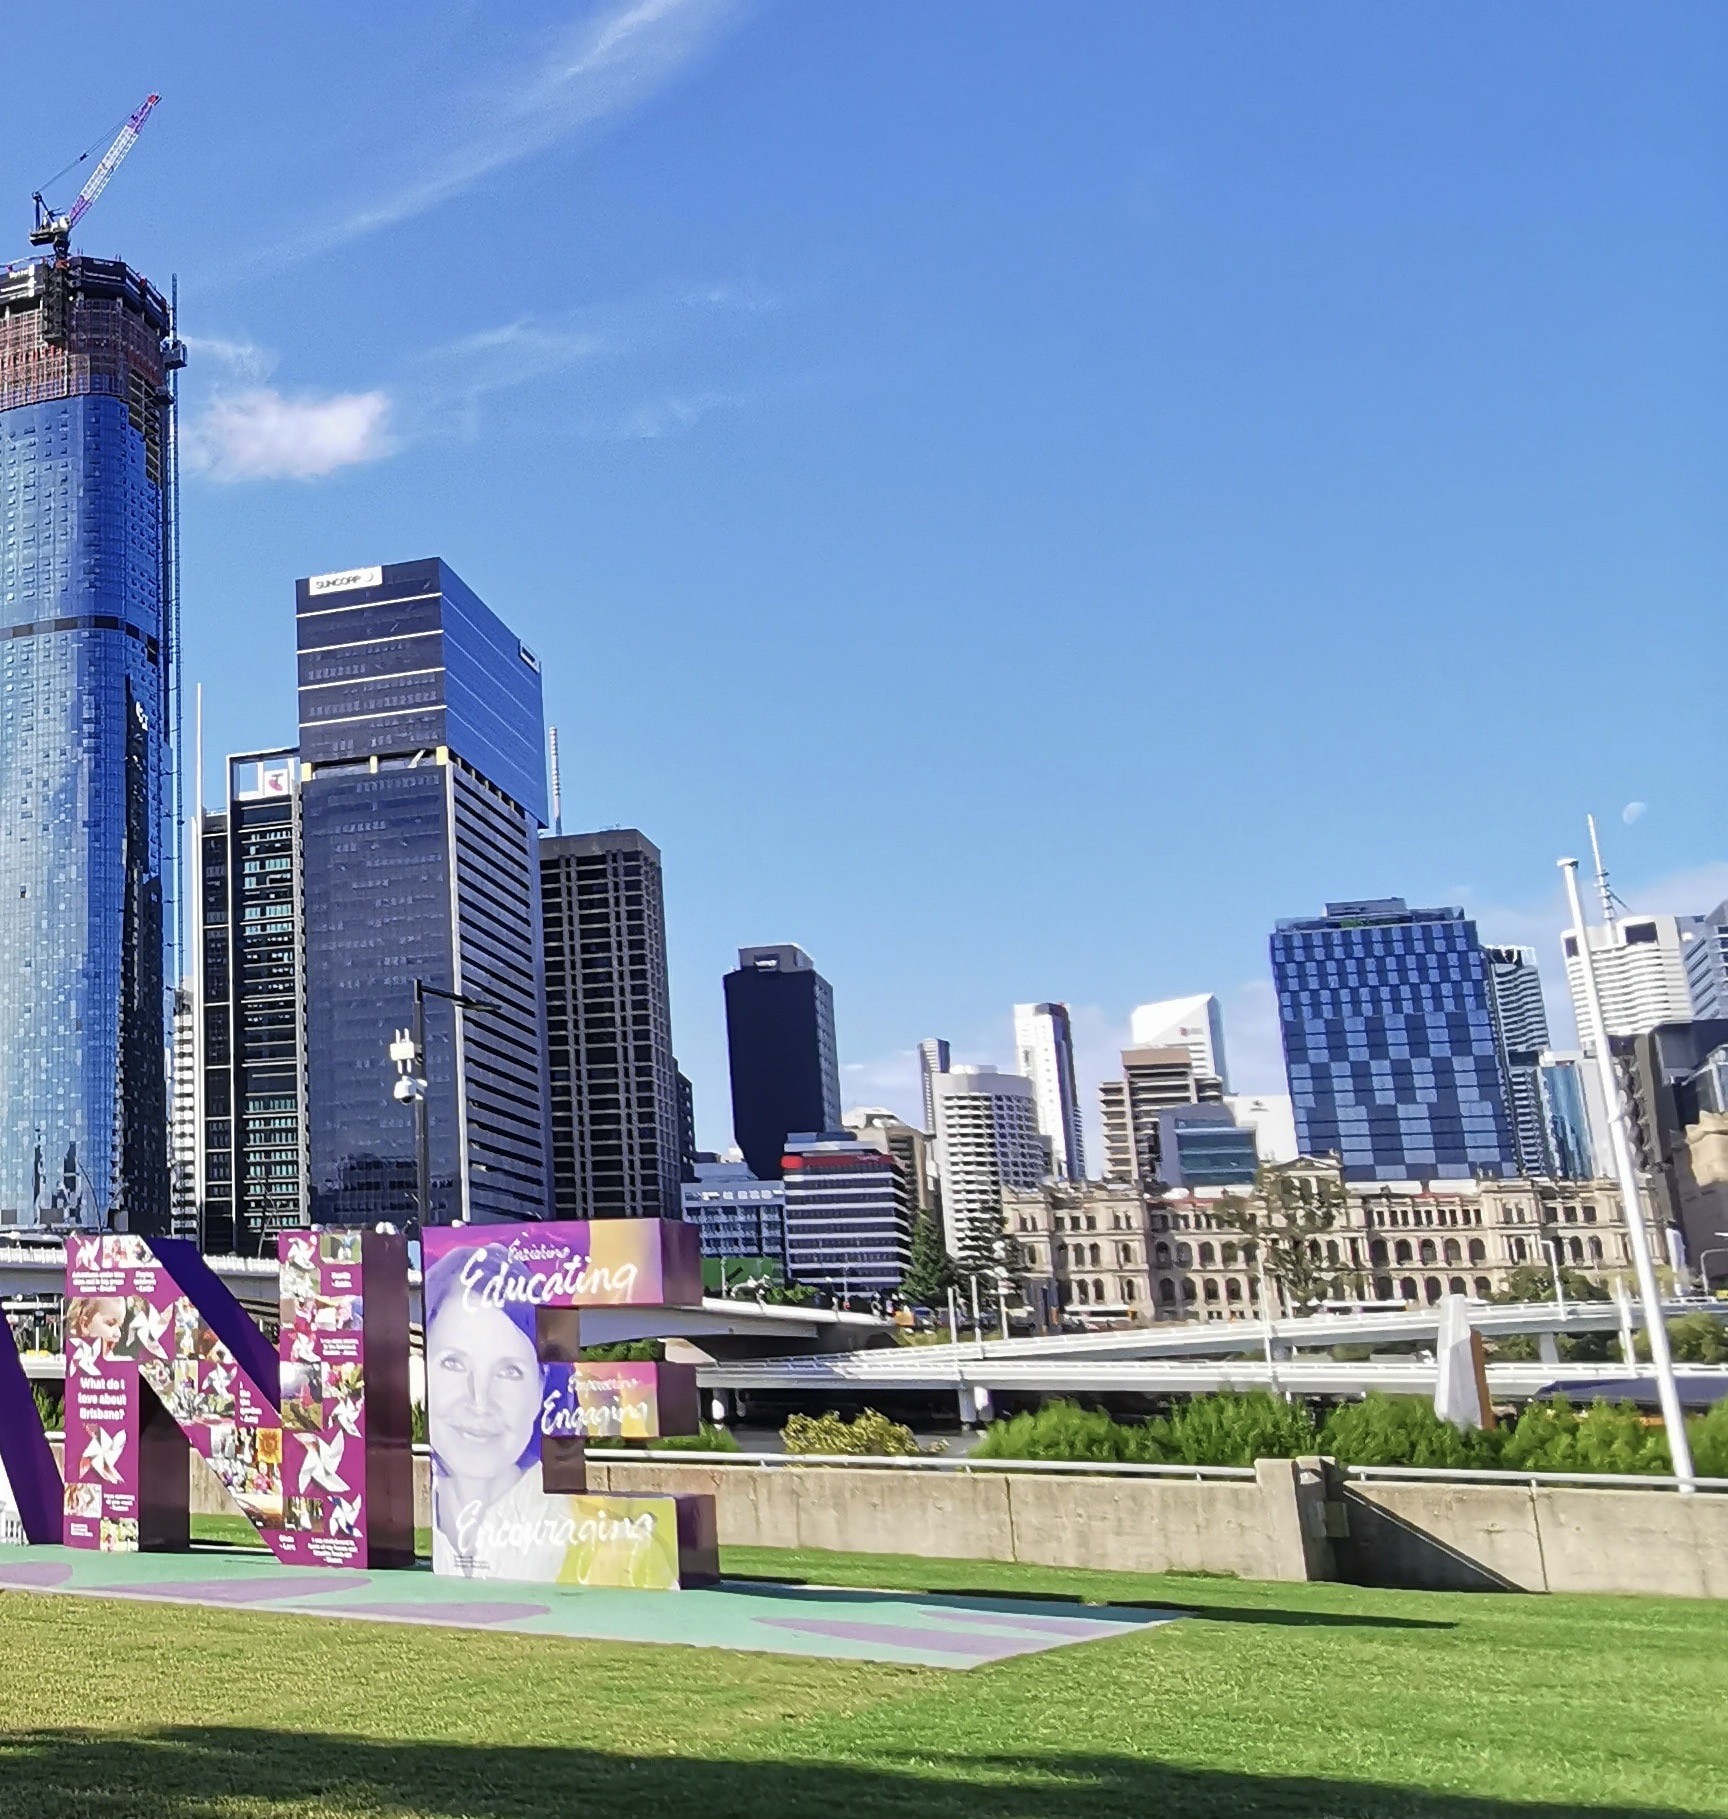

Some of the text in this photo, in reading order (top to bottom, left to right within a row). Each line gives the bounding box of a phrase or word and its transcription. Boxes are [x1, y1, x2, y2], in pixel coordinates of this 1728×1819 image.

[315, 575, 361, 590] SUNCORP
[460, 1247, 638, 1313] Educating
[79, 1376, 105, 1390] What
[106, 1377, 120, 1391] do
[77, 1391, 127, 1406] love about
[79, 1406, 126, 1421] Brisbane?
[541, 1389, 648, 1437] Engaging
[455, 1499, 654, 1582] Encouraging
